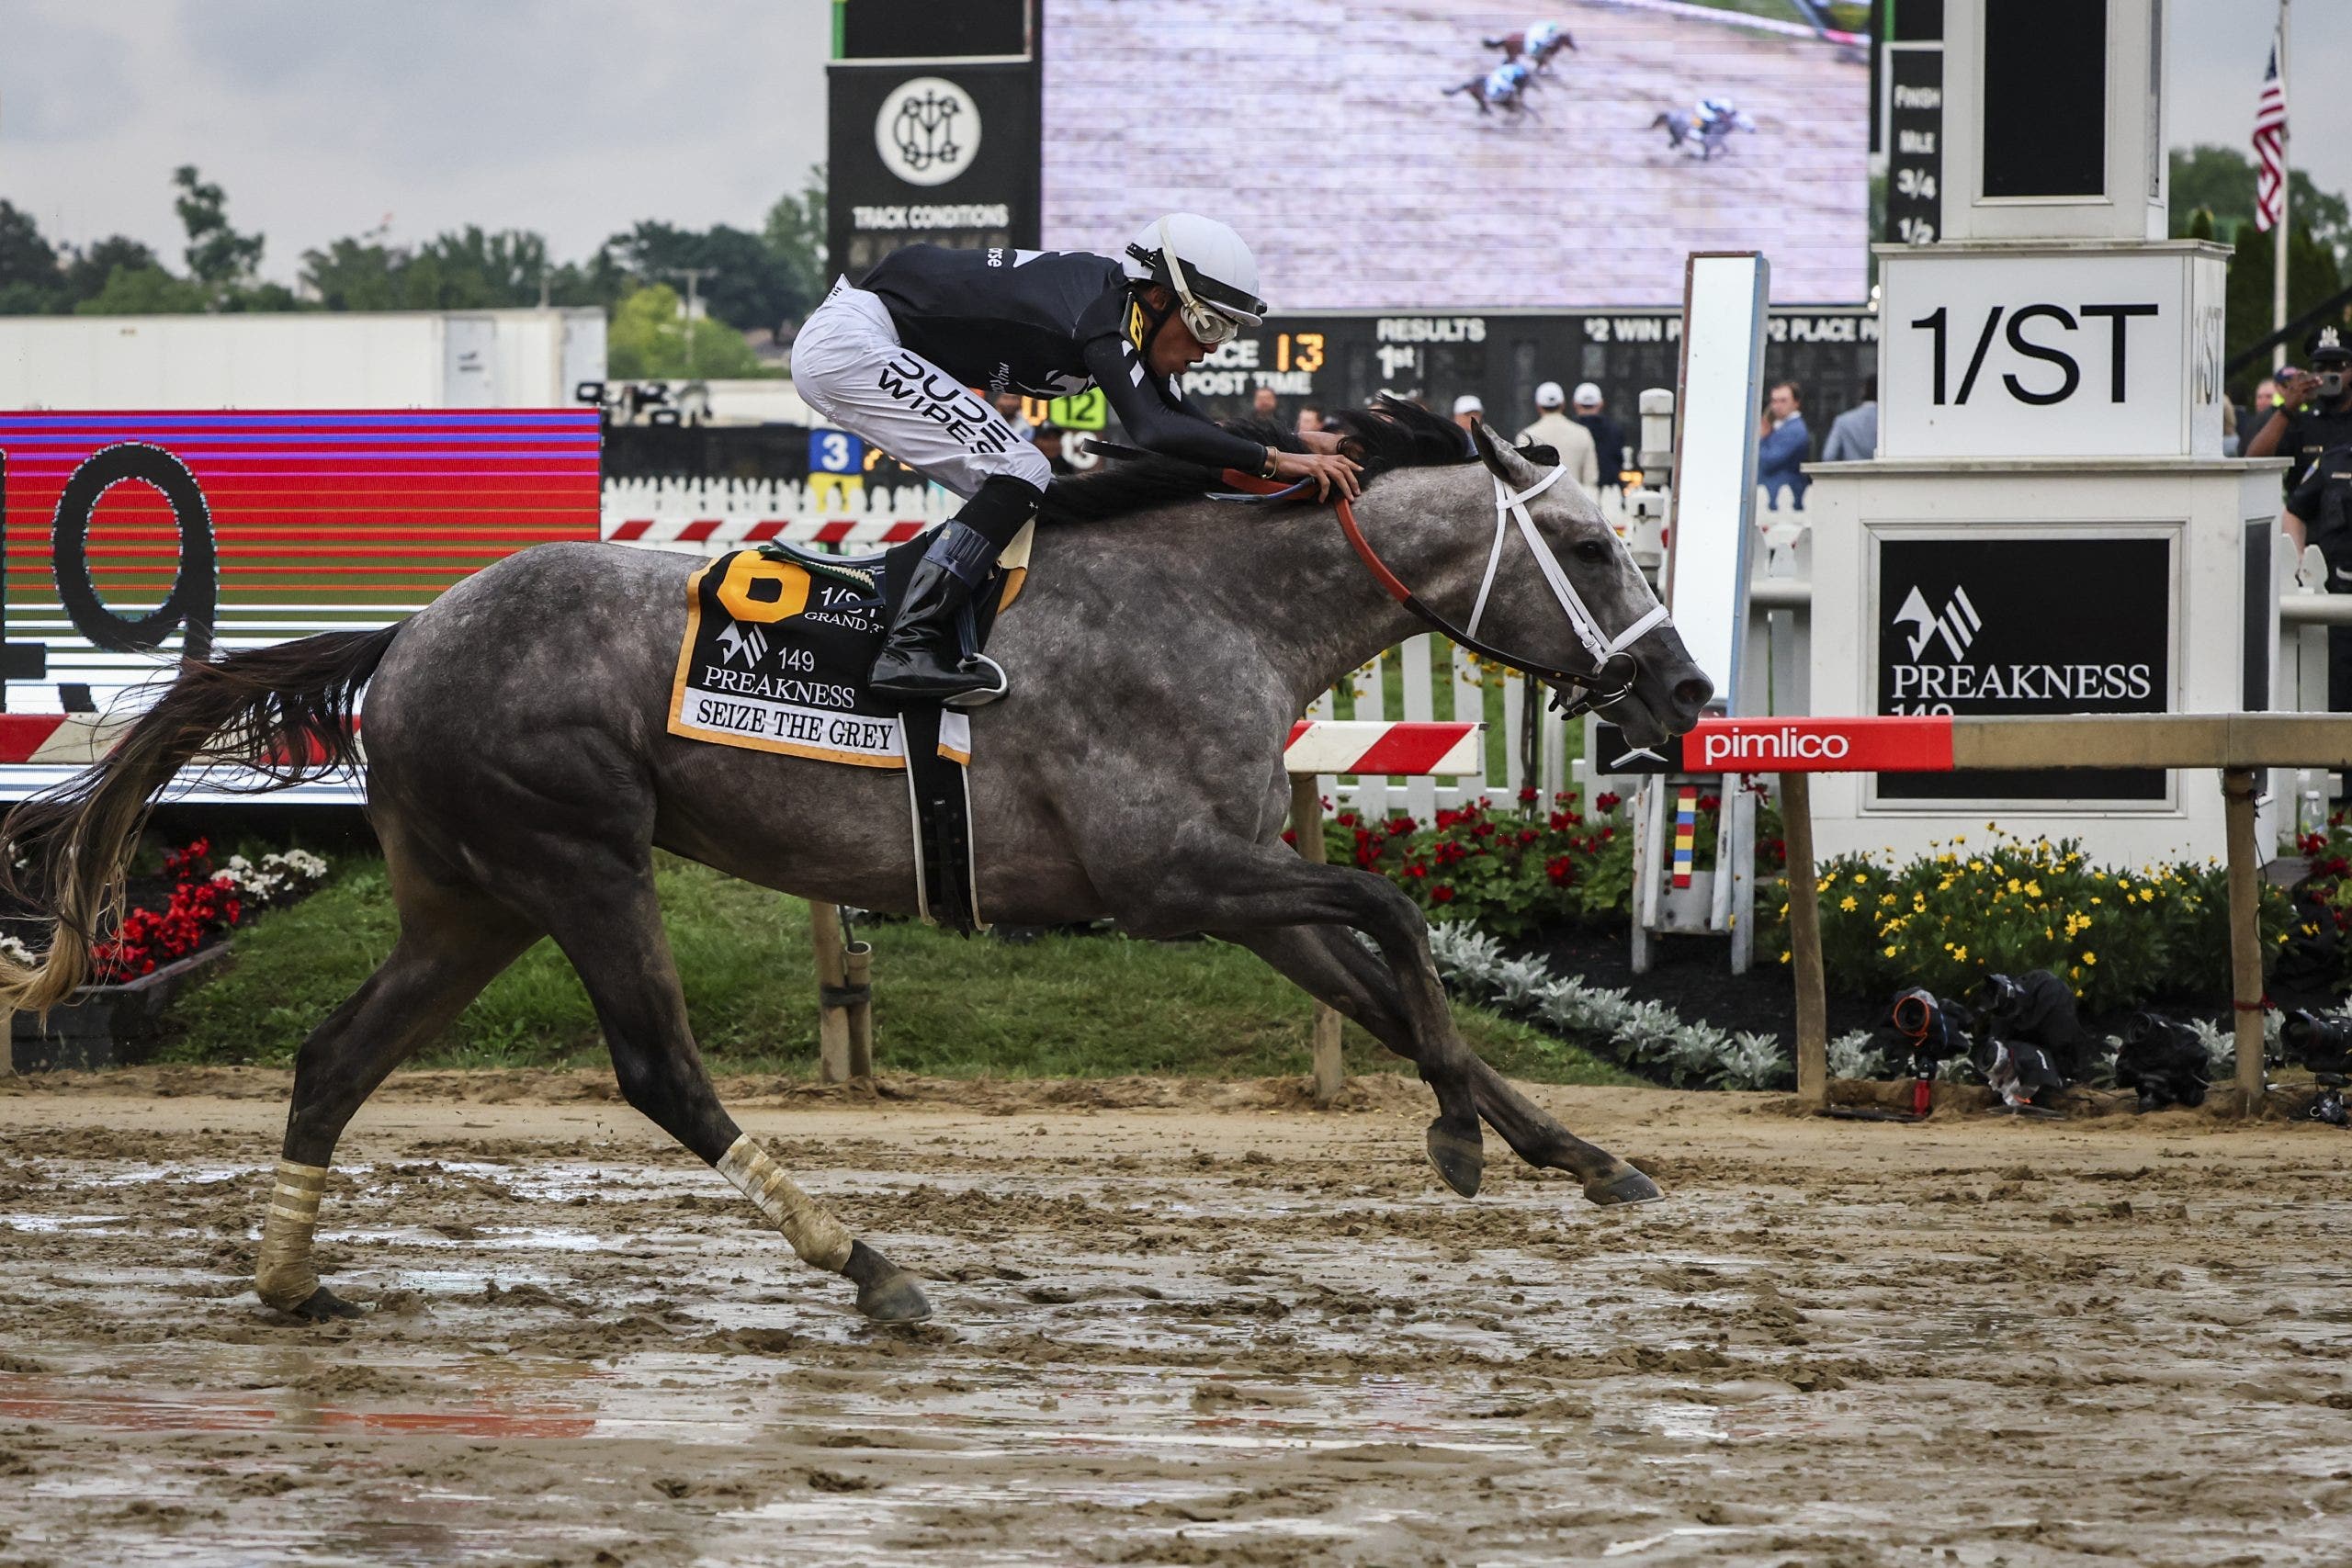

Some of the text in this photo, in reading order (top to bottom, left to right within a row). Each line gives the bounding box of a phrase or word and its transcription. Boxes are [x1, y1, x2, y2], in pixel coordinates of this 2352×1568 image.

[1897, 168, 1936, 200] 3/4
[853, 204, 1009, 229] TRACK CONDITIONS
[1376, 318, 1486, 342] RESULTS
[1614, 318, 1661, 342] WIN
[1791, 318, 1856, 342] PLACE
[1190, 333, 1324, 372] ACE 13
[1911, 304, 2158, 405] 1/ST
[1182, 371, 1312, 395] POST TIME
[878, 368, 994, 454] WIPES
[1066, 394, 1095, 422] 12
[821, 434, 850, 471] 3
[804, 612, 867, 632] GRAND
[778, 647, 815, 672] 149
[702, 665, 855, 709] PREAKNESS
[1891, 664, 2152, 700] PREAKNESS
[696, 699, 894, 750] SEIZE THE GREY
[1705, 728, 1849, 766] pimlico
